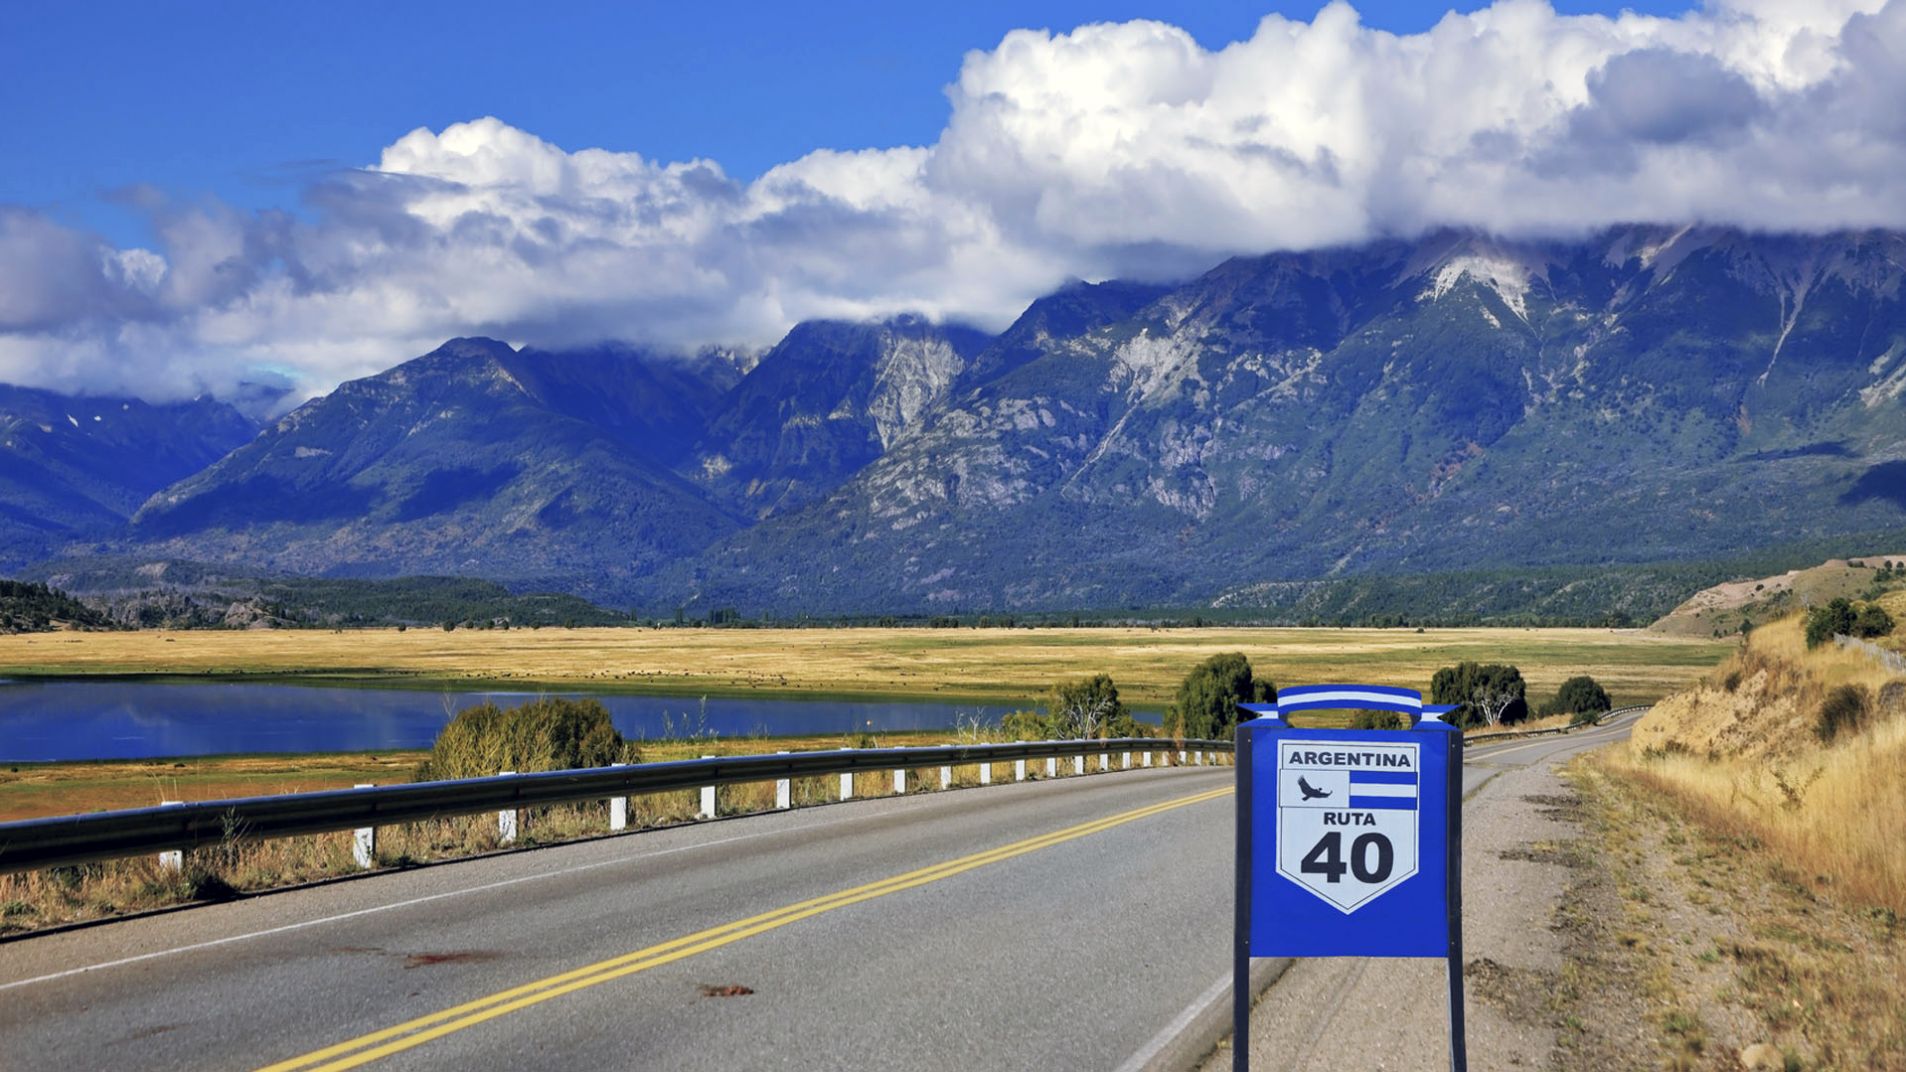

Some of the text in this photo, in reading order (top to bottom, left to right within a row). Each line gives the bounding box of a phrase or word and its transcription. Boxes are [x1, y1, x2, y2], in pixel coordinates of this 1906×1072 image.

[1289, 751, 1411, 768] ARGENTINA
[1323, 812, 1376, 826] RUTA
[1300, 831, 1394, 884] 40
